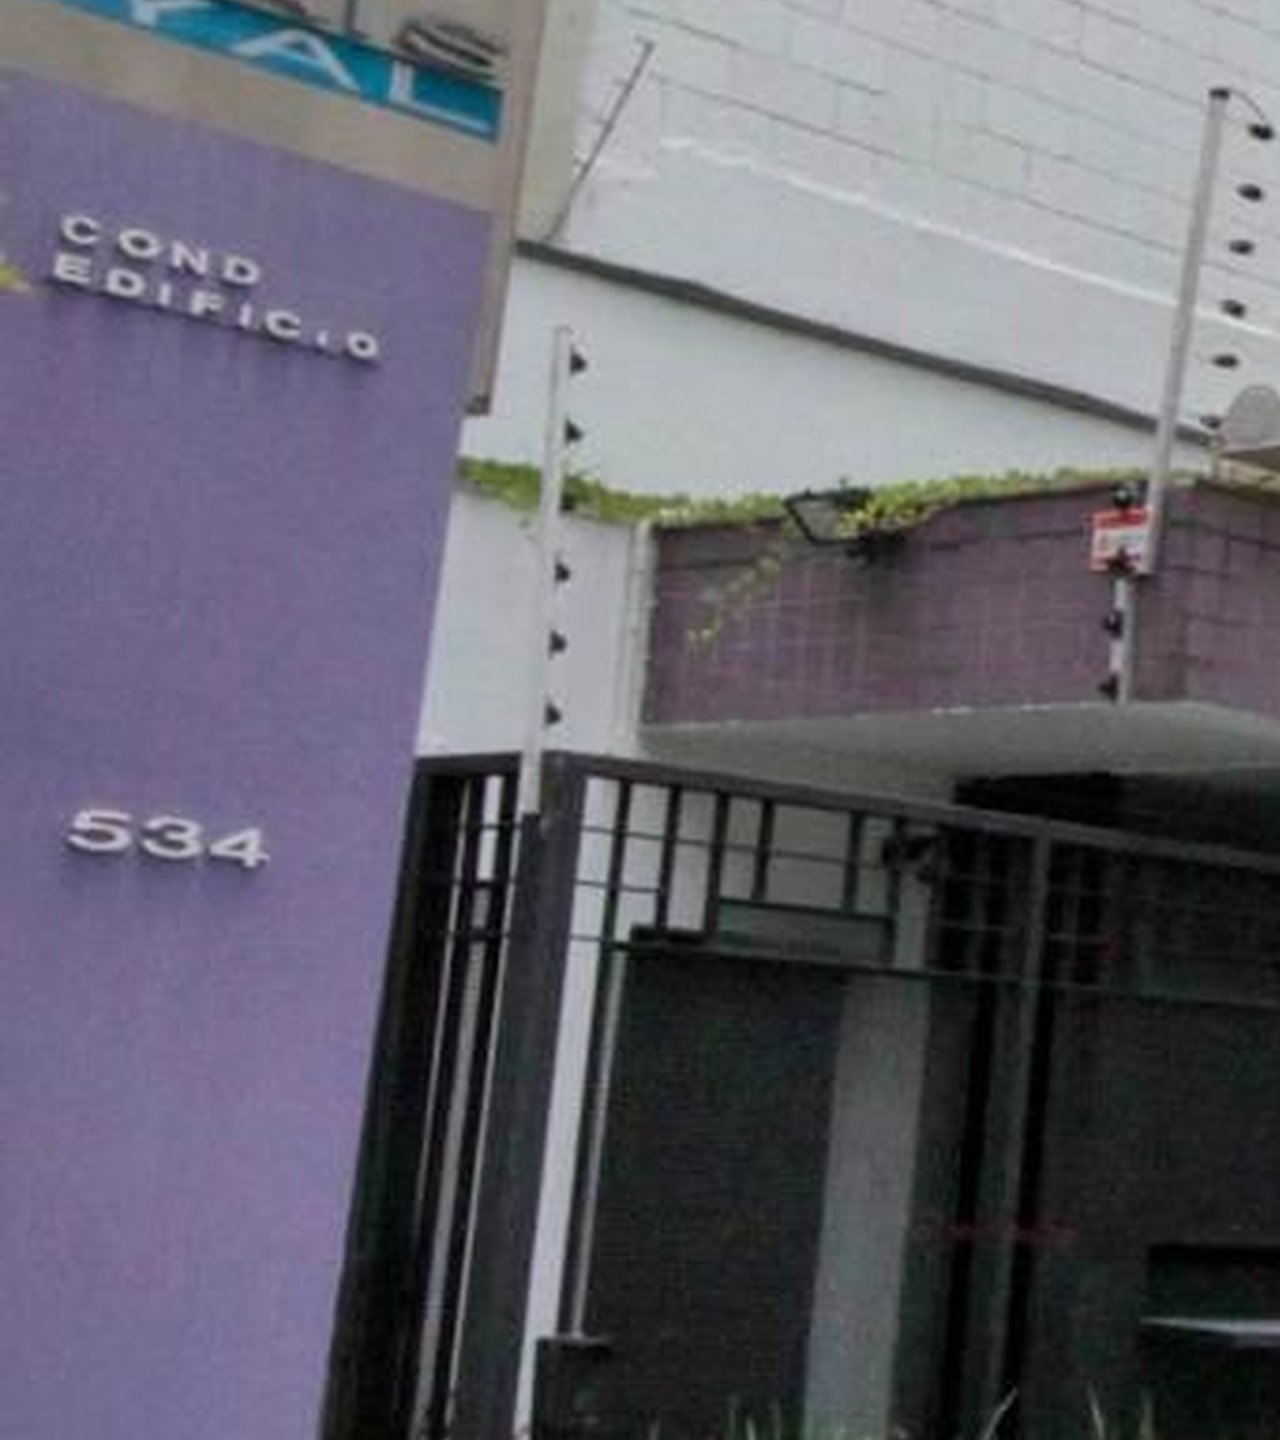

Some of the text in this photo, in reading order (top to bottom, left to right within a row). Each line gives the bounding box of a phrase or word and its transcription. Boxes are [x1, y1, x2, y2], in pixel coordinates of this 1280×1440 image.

[60, 216, 261, 285] COND
[53, 252, 379, 359] EDIFICIO
[67, 810, 271, 868] 534
